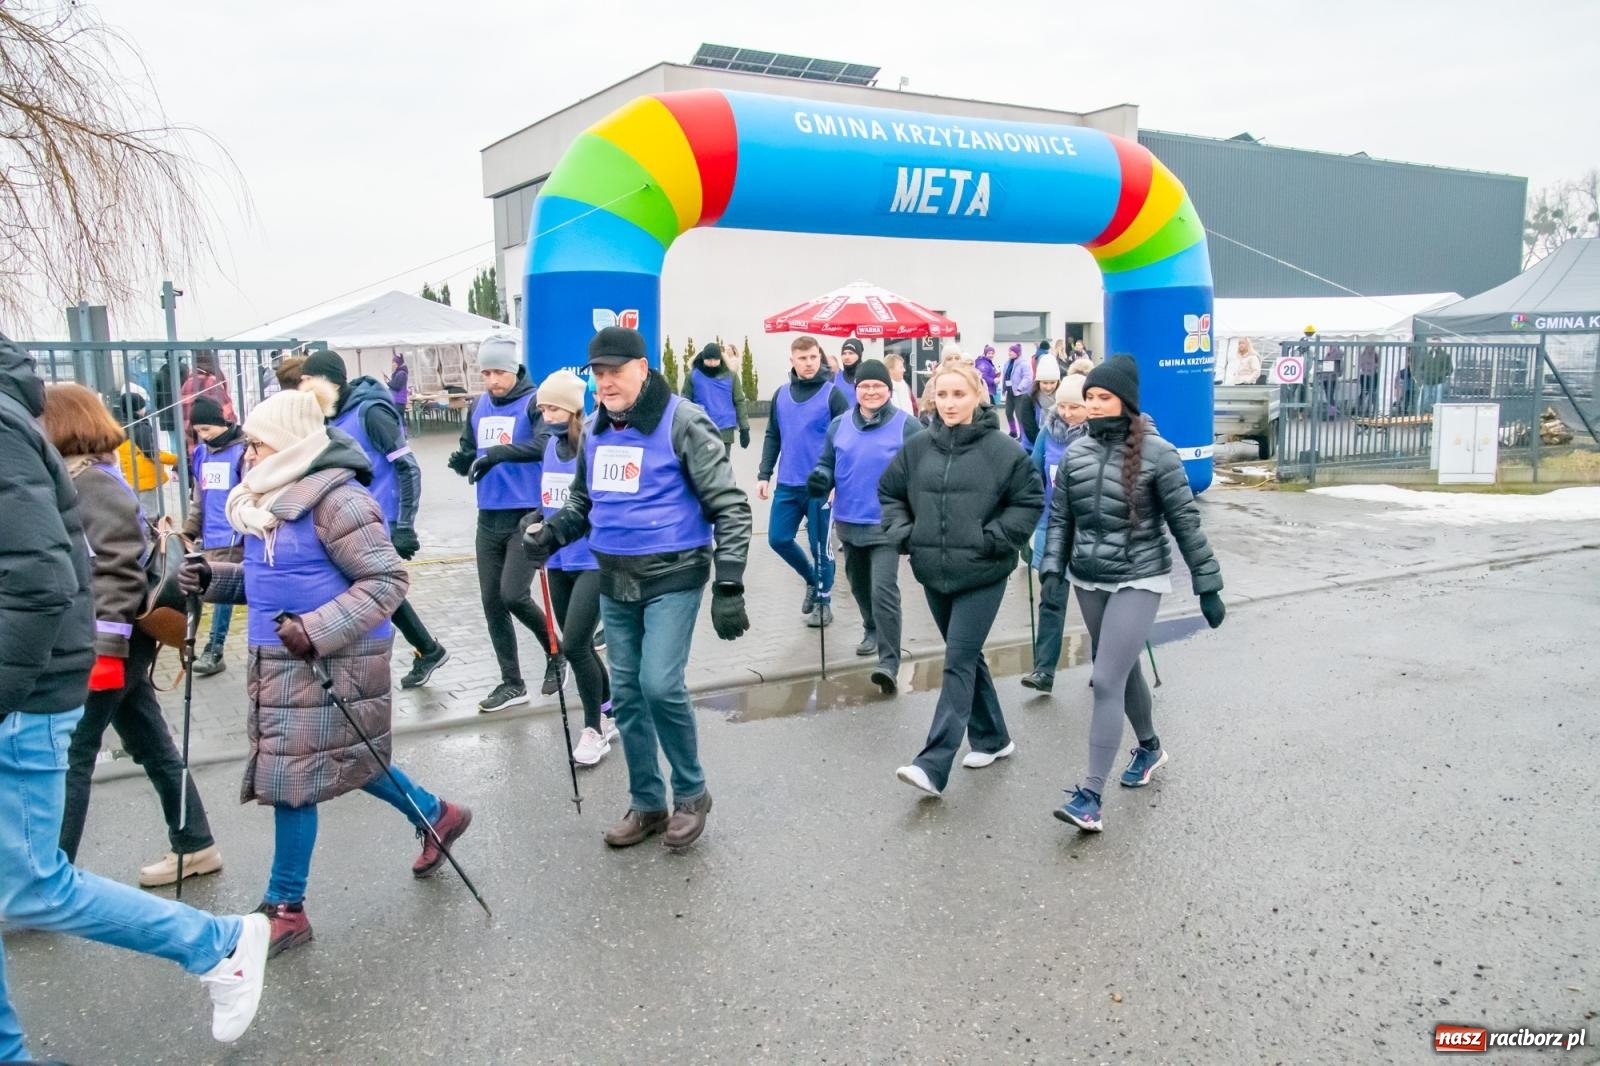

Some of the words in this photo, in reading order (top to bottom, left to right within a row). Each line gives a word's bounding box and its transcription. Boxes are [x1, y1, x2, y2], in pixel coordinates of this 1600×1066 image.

[794, 111, 888, 142] GMINA
[891, 121, 1077, 157] KRZYŻANOWICE
[889, 166, 991, 217] META
[1535, 316, 1585, 329] GMINA
[1158, 358, 1186, 368] GMINA
[1283, 365, 1297, 376] 20
[485, 427, 504, 441] 117
[600, 463, 626, 482] 101
[548, 487, 568, 502] 116
